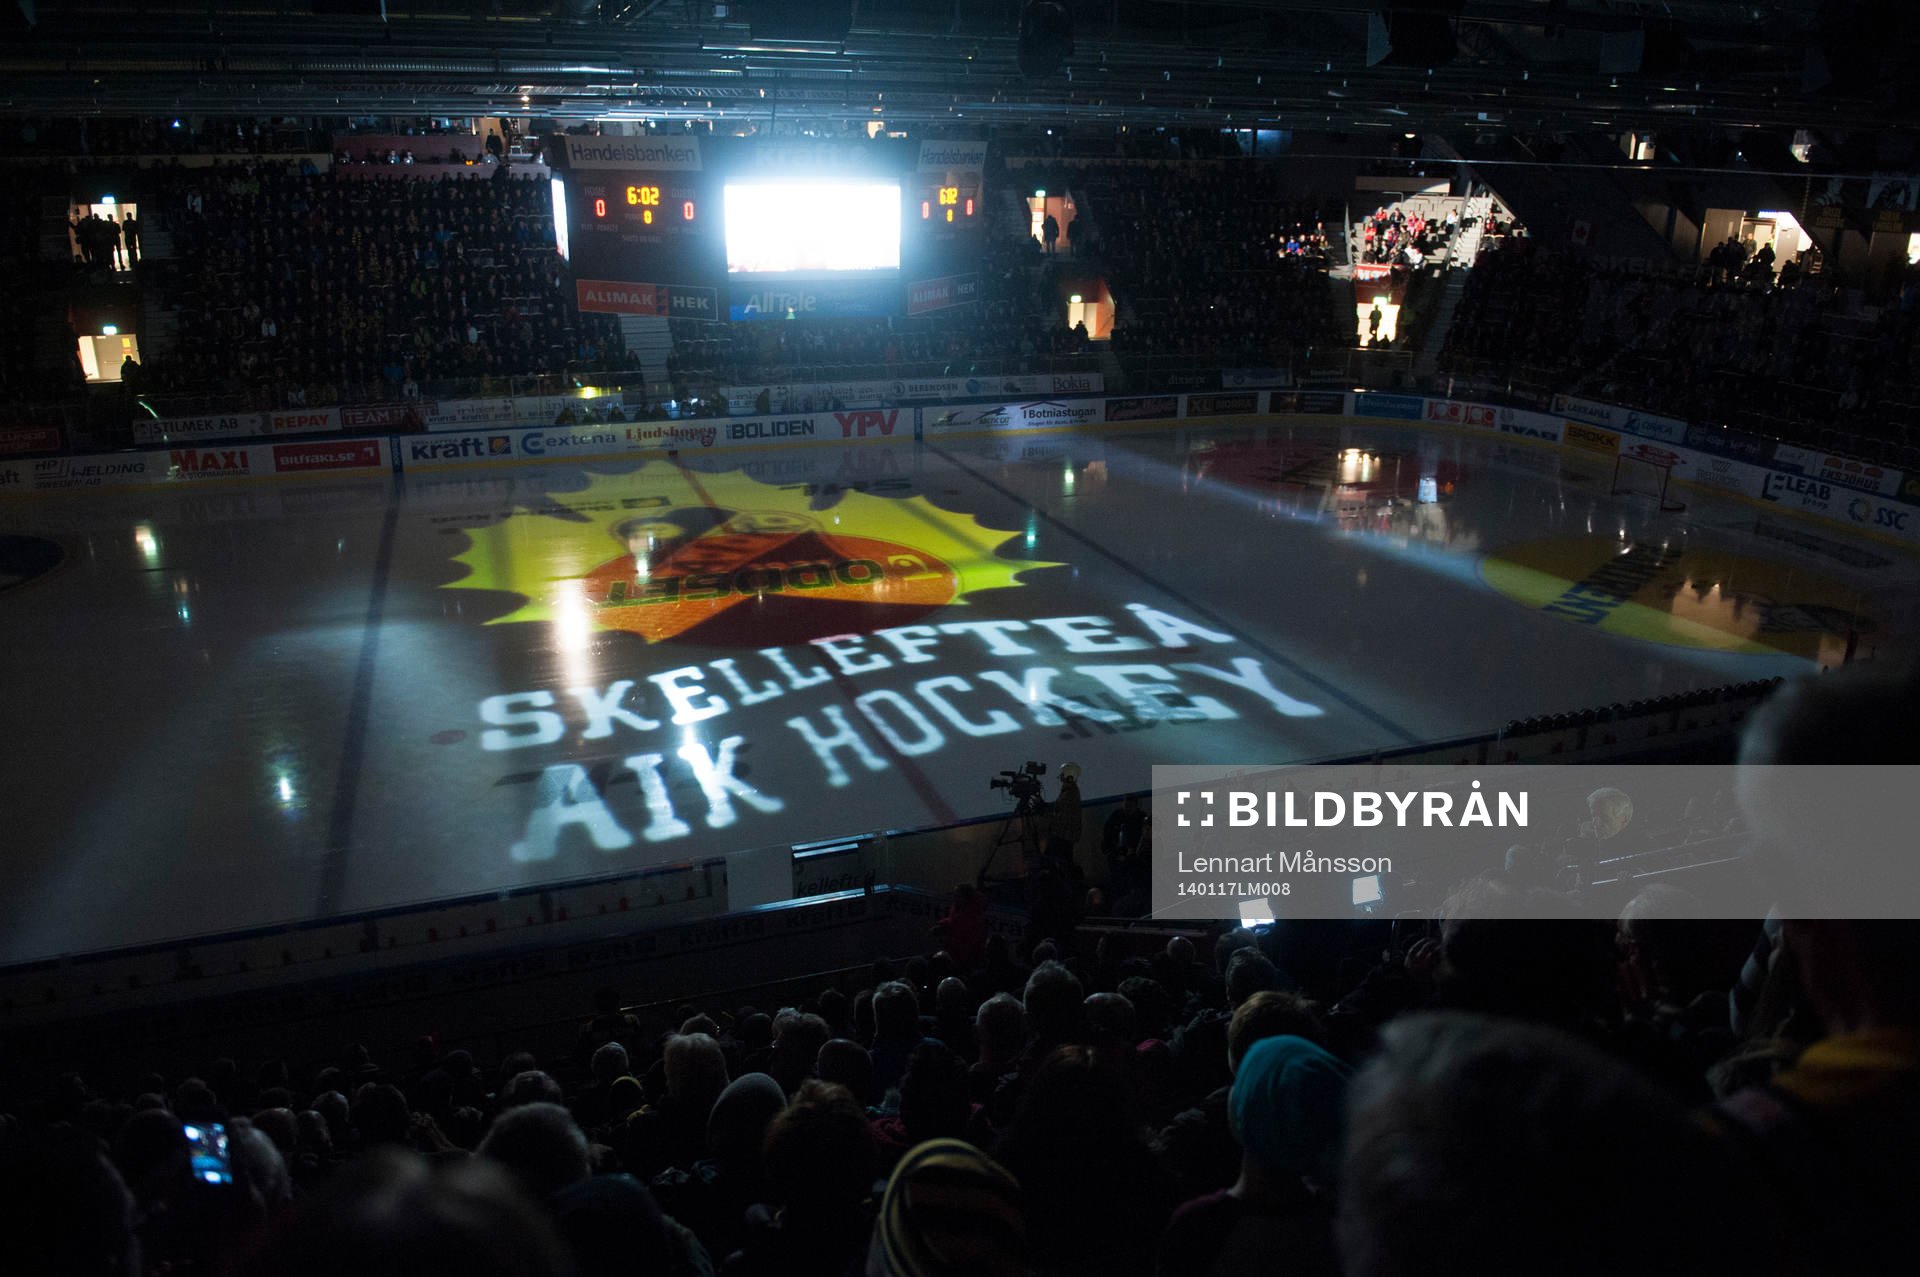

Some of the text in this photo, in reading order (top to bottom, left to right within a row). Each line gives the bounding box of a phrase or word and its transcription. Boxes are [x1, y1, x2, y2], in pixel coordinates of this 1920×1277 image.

[570, 142, 696, 163] Handelsbanken
[921, 147, 984, 166] Handelsbanken
[626, 185, 660, 206] 6:02
[593, 198, 607, 218] 0
[683, 201, 694, 220] 0
[585, 288, 711, 311] ALIMAK HEK
[744, 291, 817, 314] AllTele
[274, 414, 329, 430] REPAY
[345, 408, 390, 424] TEAM
[833, 409, 900, 438] YPV
[1028, 405, 1097, 420] Botniastugan
[154, 417, 239, 435] STILMEK AB
[731, 418, 815, 440] BOLIDEN
[1567, 424, 1617, 448] BROKK
[411, 436, 485, 461] kraft
[70, 463, 146, 478] WELDING
[170, 449, 250, 472] MAXI
[1785, 476, 1832, 501] LEAB
[1873, 506, 1910, 532] SSC
[475, 601, 1239, 751] SKELLEFTEÅ
[509, 734, 786, 862] AIK
[786, 655, 1326, 789] HOCKEY
